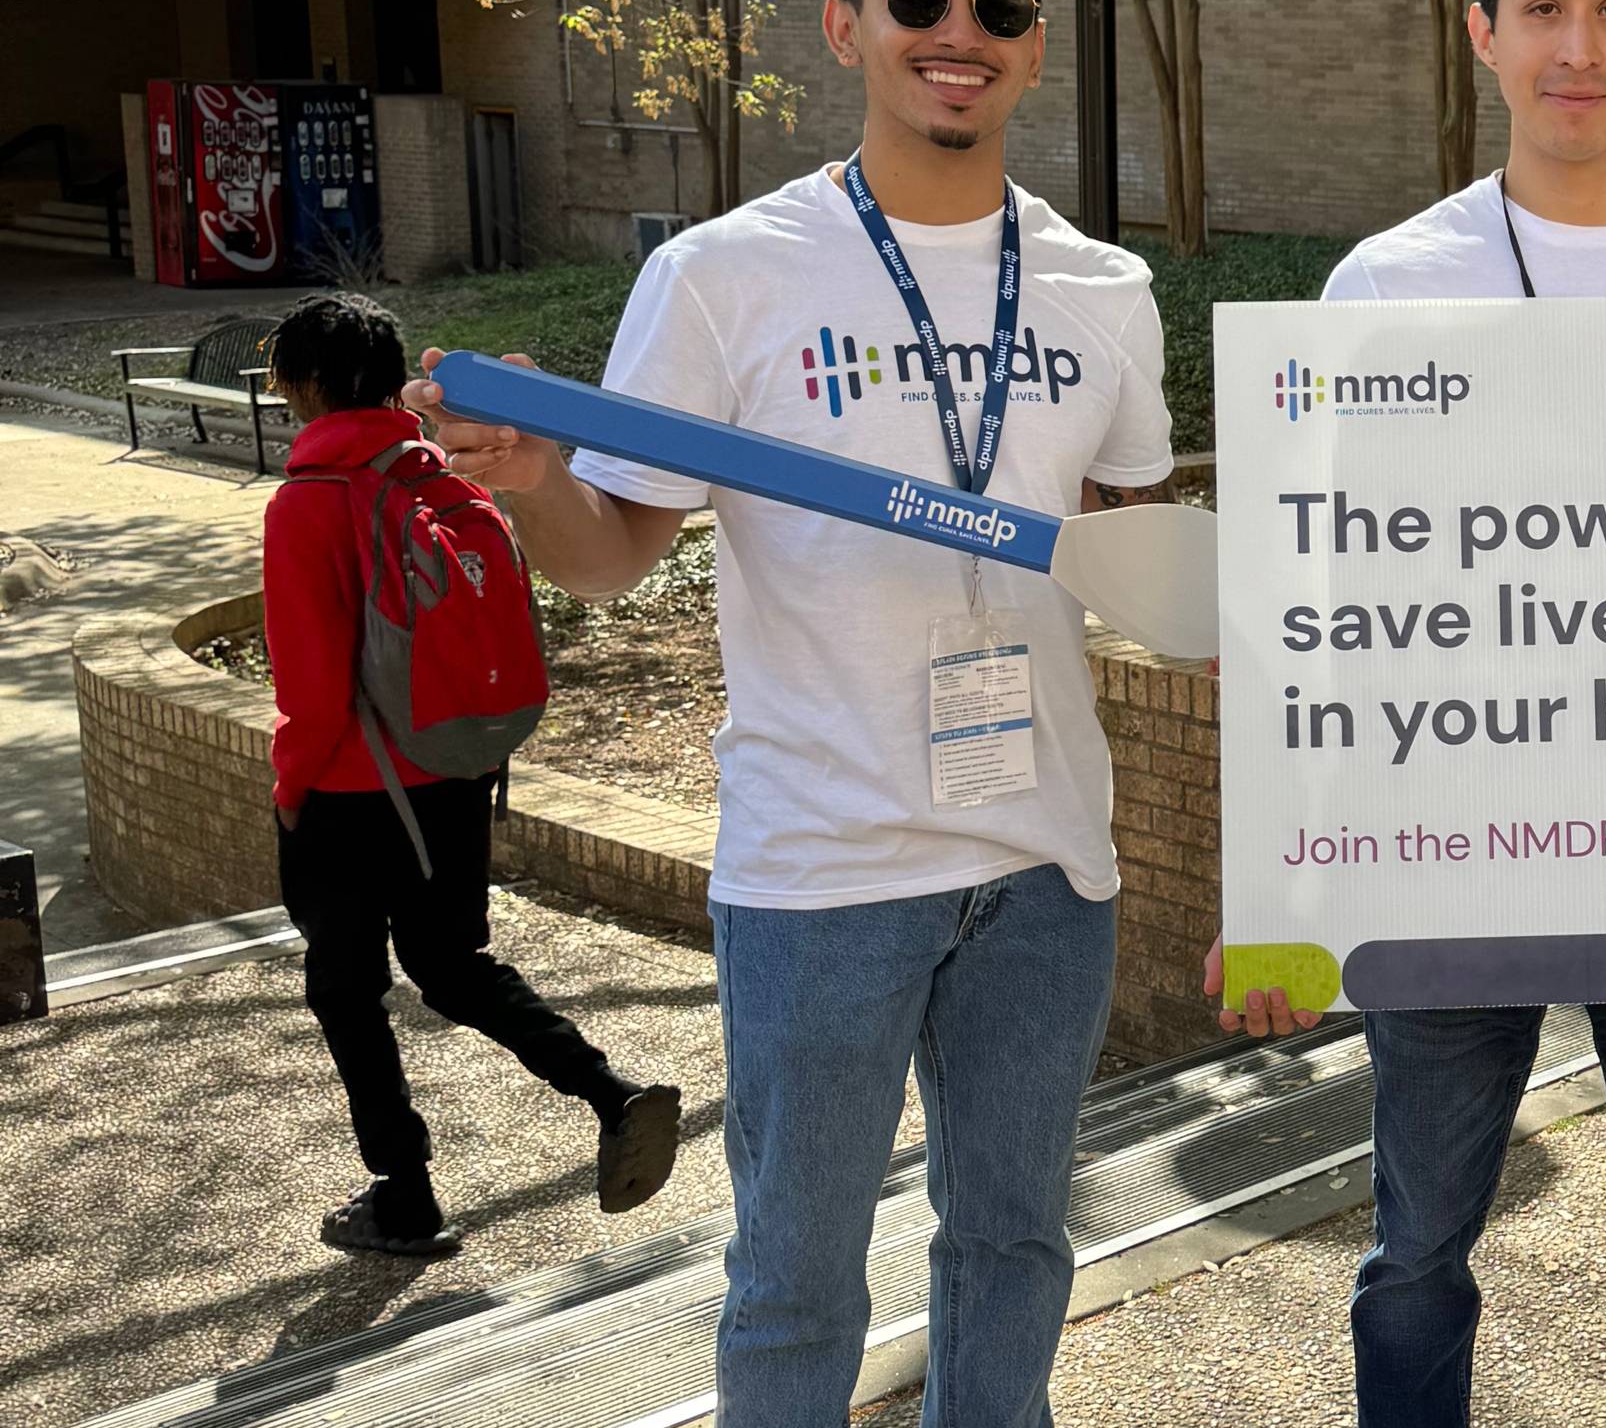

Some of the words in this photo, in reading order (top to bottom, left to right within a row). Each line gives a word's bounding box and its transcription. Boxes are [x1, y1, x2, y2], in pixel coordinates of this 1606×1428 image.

[303, 101, 356, 115] DASANI
[881, 239, 906, 276] nmdp
[1000, 264, 1017, 301] nmdp
[919, 320, 941, 359] nmdp
[990, 344, 1009, 383] nmdp
[901, 391, 928, 403] FIND
[932, 391, 970, 403] CES.
[1009, 390, 1045, 403] LIVES.
[1334, 360, 1472, 416] nmdp
[944, 409, 961, 450] nmdp
[1335, 407, 1355, 416] FIND
[1357, 407, 1384, 416] CURES.
[1388, 406, 1409, 415] SAVE
[977, 430, 995, 471] nmdp
[926, 500, 1018, 548] nmdp
[1279, 491, 1431, 554] The
[1283, 603, 1470, 651] save
[1284, 686, 1355, 748] in
[1381, 696, 1567, 764] your
[1284, 827, 1378, 865] Join
[1395, 825, 1471, 861] the
